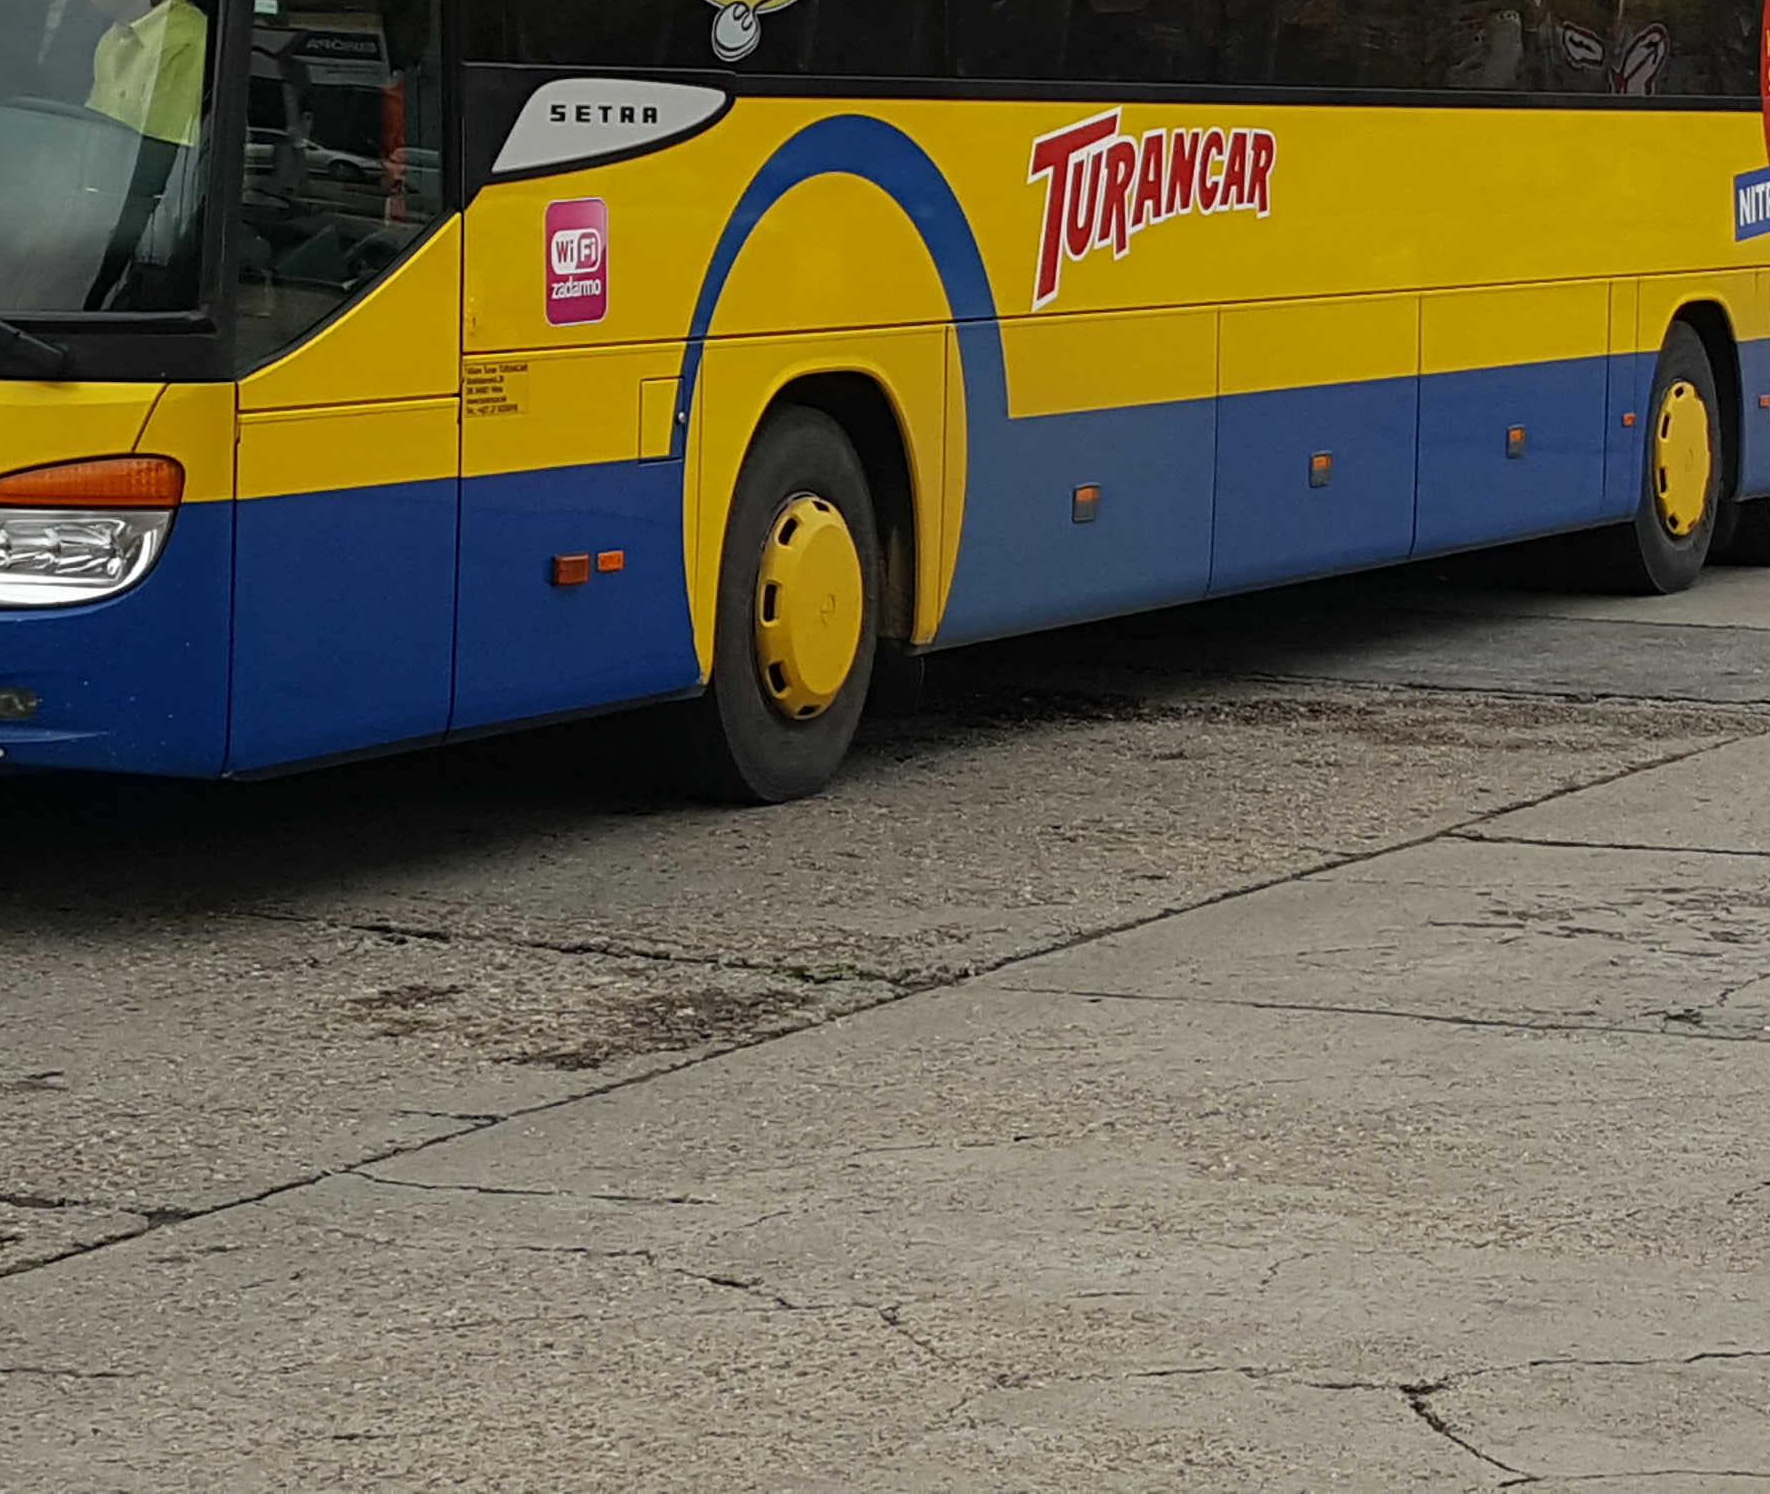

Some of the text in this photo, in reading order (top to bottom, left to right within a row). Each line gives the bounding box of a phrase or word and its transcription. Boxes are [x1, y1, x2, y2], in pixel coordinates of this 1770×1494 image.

[550, 104, 658, 124] SETRA
[1027, 105, 1277, 313] TURANCAR
[551, 275, 602, 300] zadarmo
